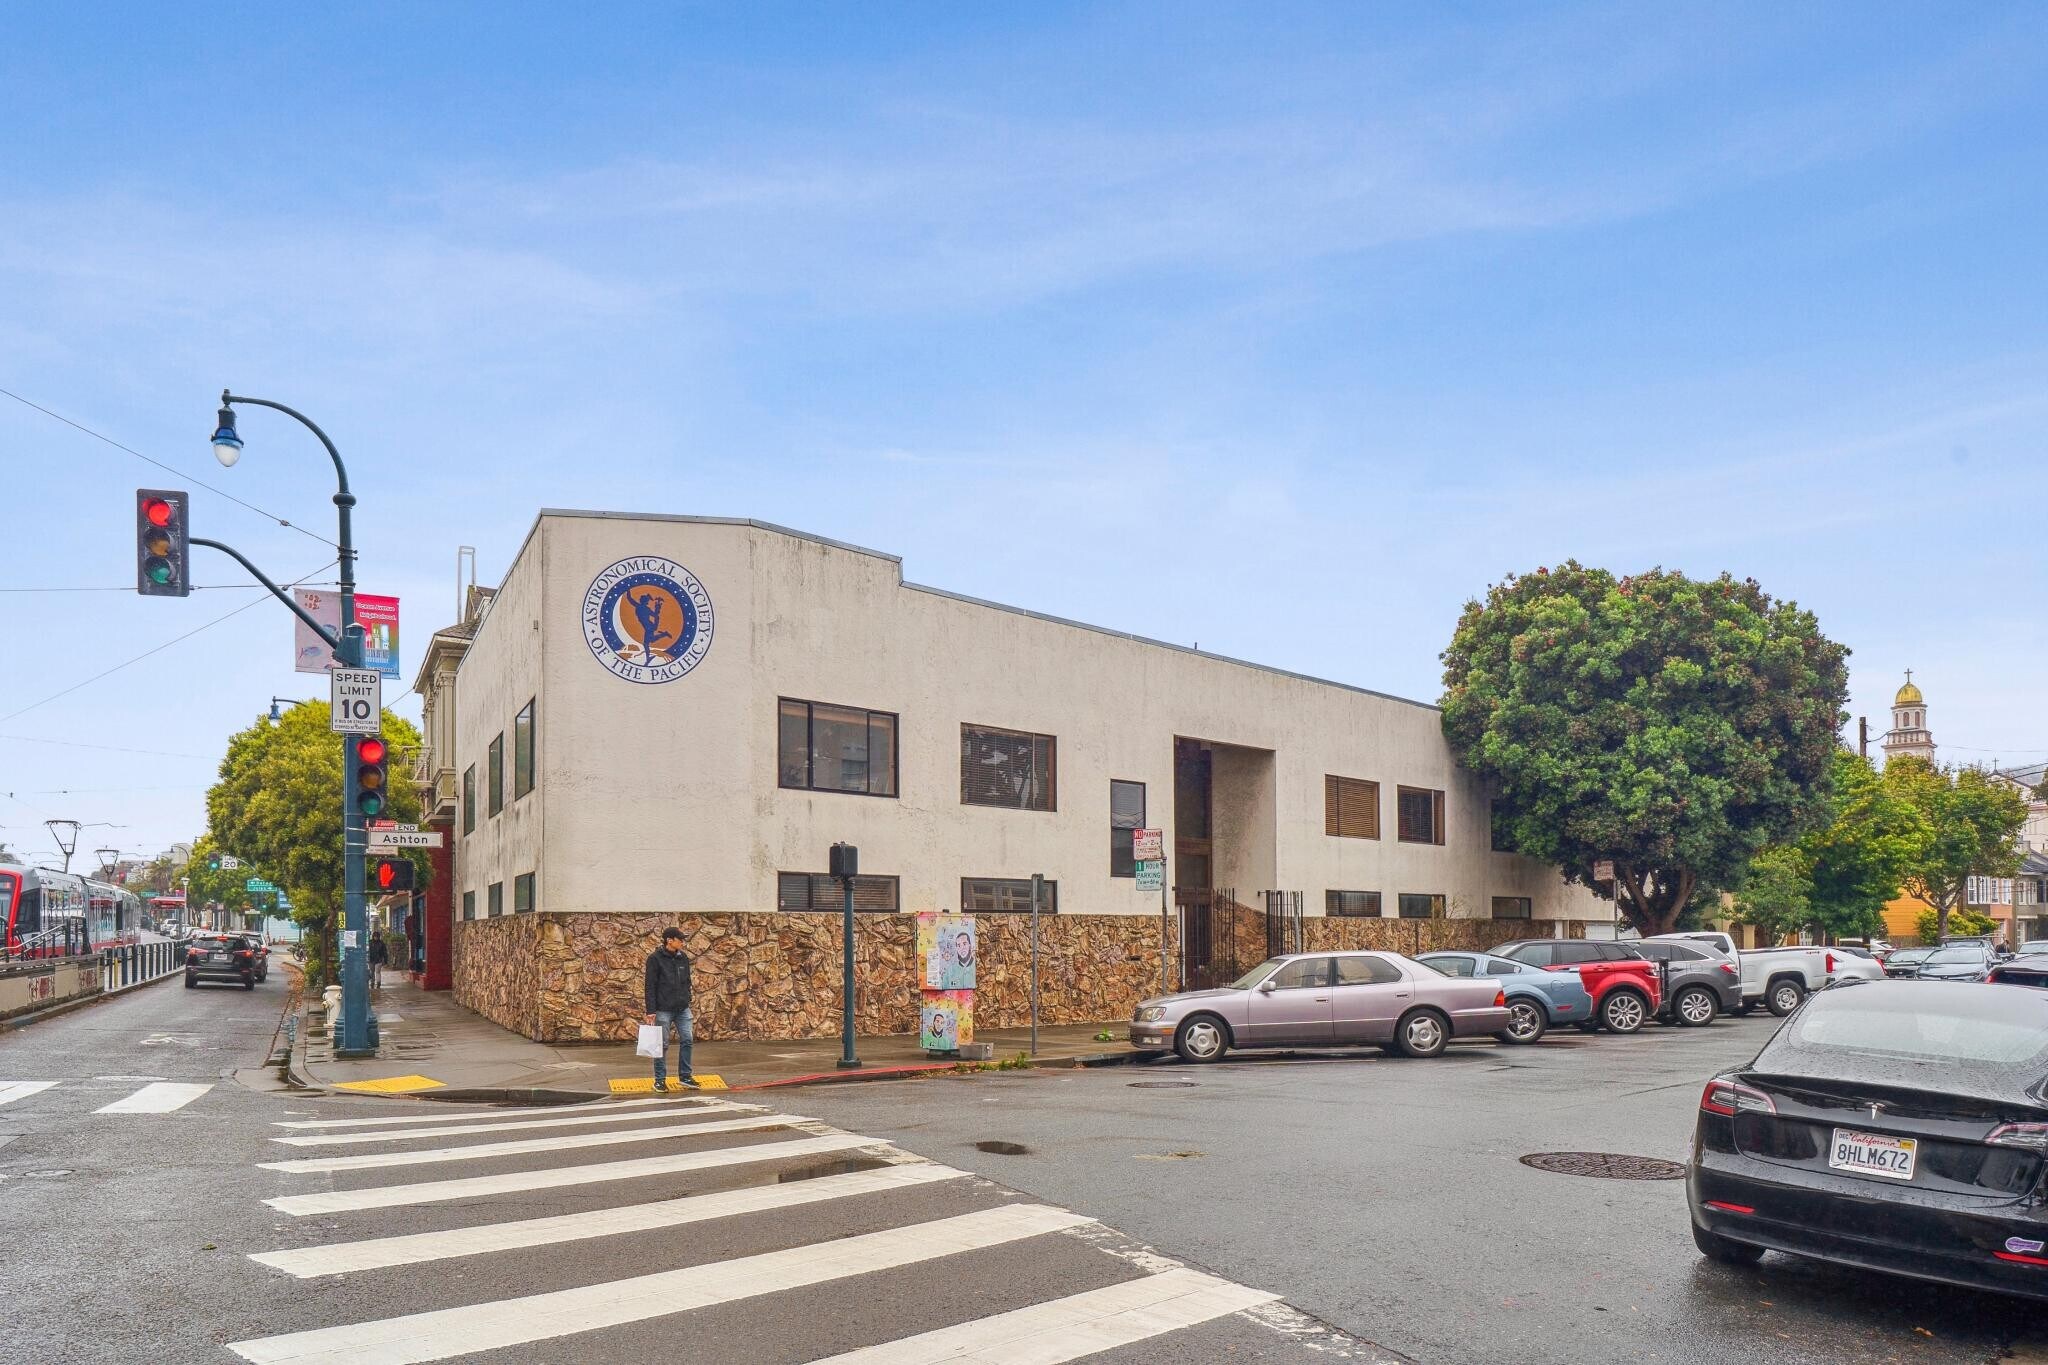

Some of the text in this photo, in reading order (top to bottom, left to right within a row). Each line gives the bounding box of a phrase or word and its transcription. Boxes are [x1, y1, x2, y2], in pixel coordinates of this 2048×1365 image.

[586, 559, 712, 638] ASTRONOMICAL SOCIETY
[591, 637, 704, 681] OF THE PACIFIC
[336, 673, 377, 684] SPEED
[340, 686, 372, 696] LIMIT
[342, 699, 371, 720] 10
[383, 834, 428, 844] Ashton
[1134, 830, 1143, 838] NO
[1850, 1133, 1900, 1148] California
[1837, 1143, 1909, 1170] 8HLM672
